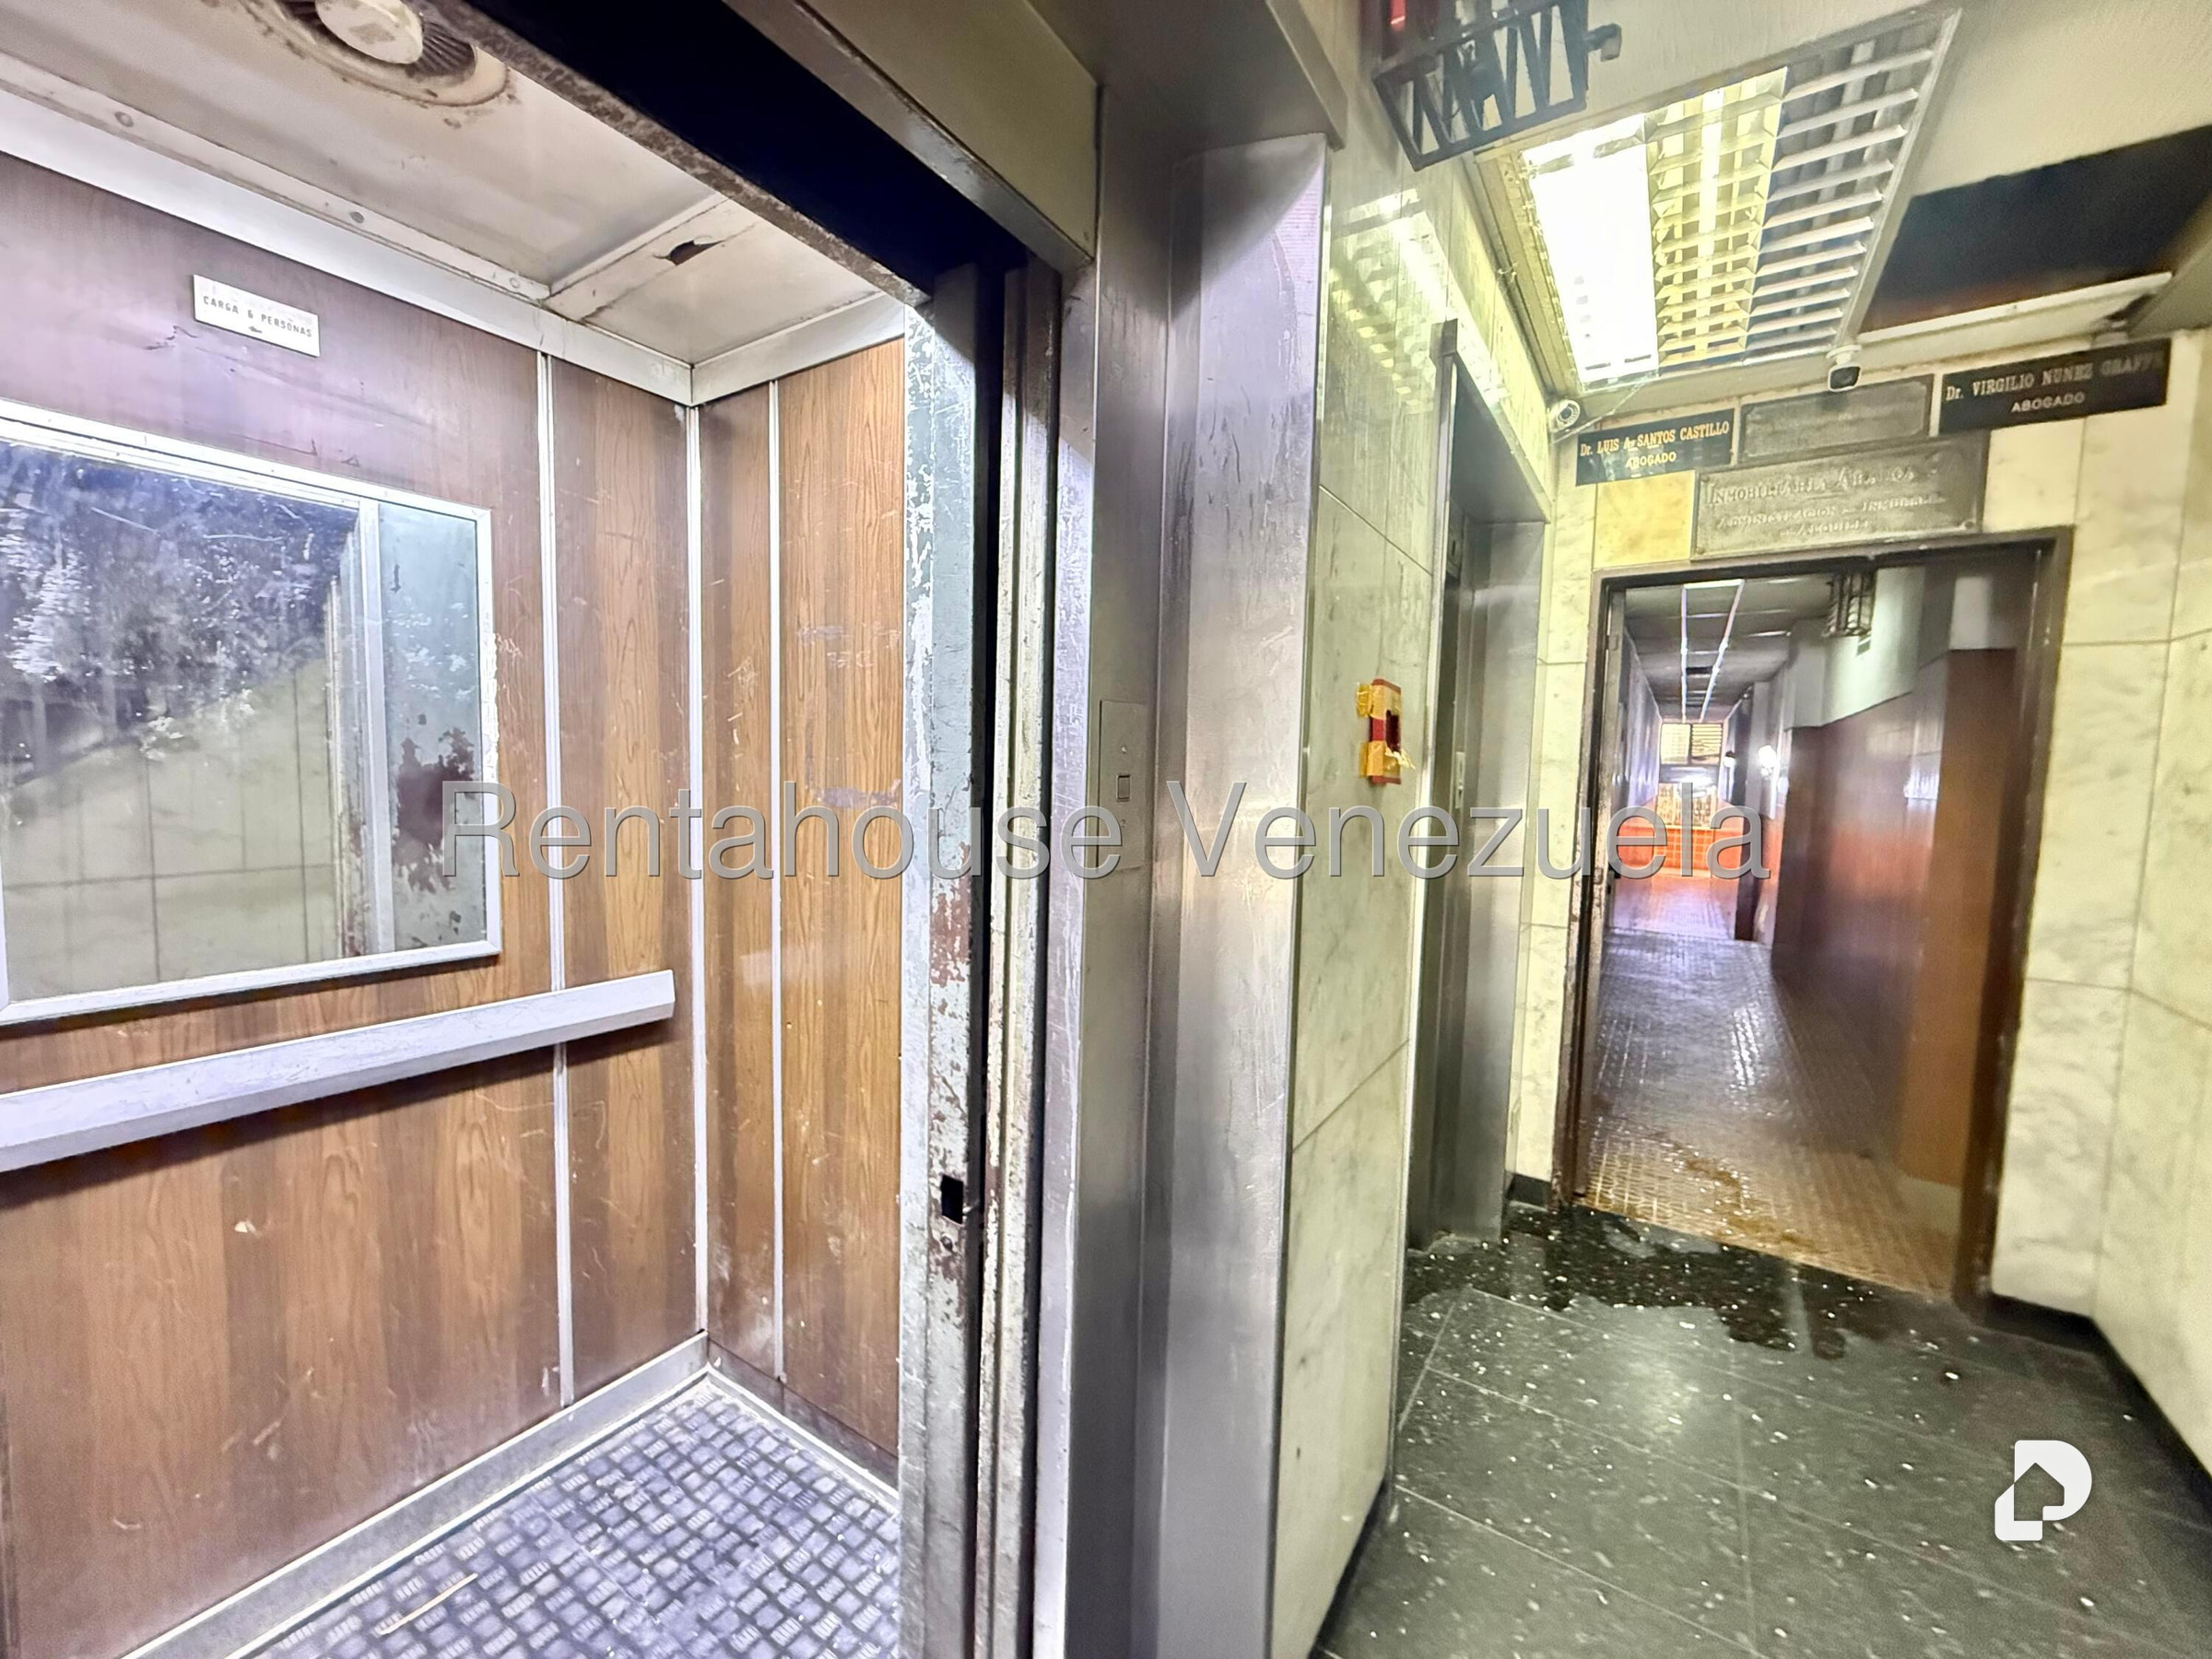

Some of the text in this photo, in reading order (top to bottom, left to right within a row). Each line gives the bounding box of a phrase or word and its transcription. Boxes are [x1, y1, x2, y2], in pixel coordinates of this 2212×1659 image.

[203, 295, 239, 314] CARGA
[261, 313, 312, 337] PERSONAS
[1946, 385, 1965, 401] Dr.
[1972, 373, 2034, 396] VIRGILIO
[2011, 392, 2086, 413] ABOGADO
[1580, 442, 1594, 457] Dr.
[1597, 438, 1619, 454] LUIS
[1637, 429, 1676, 447] SANTOS
[1679, 420, 1730, 441] CASTILLO
[1626, 451, 1677, 470] ABOGADO
